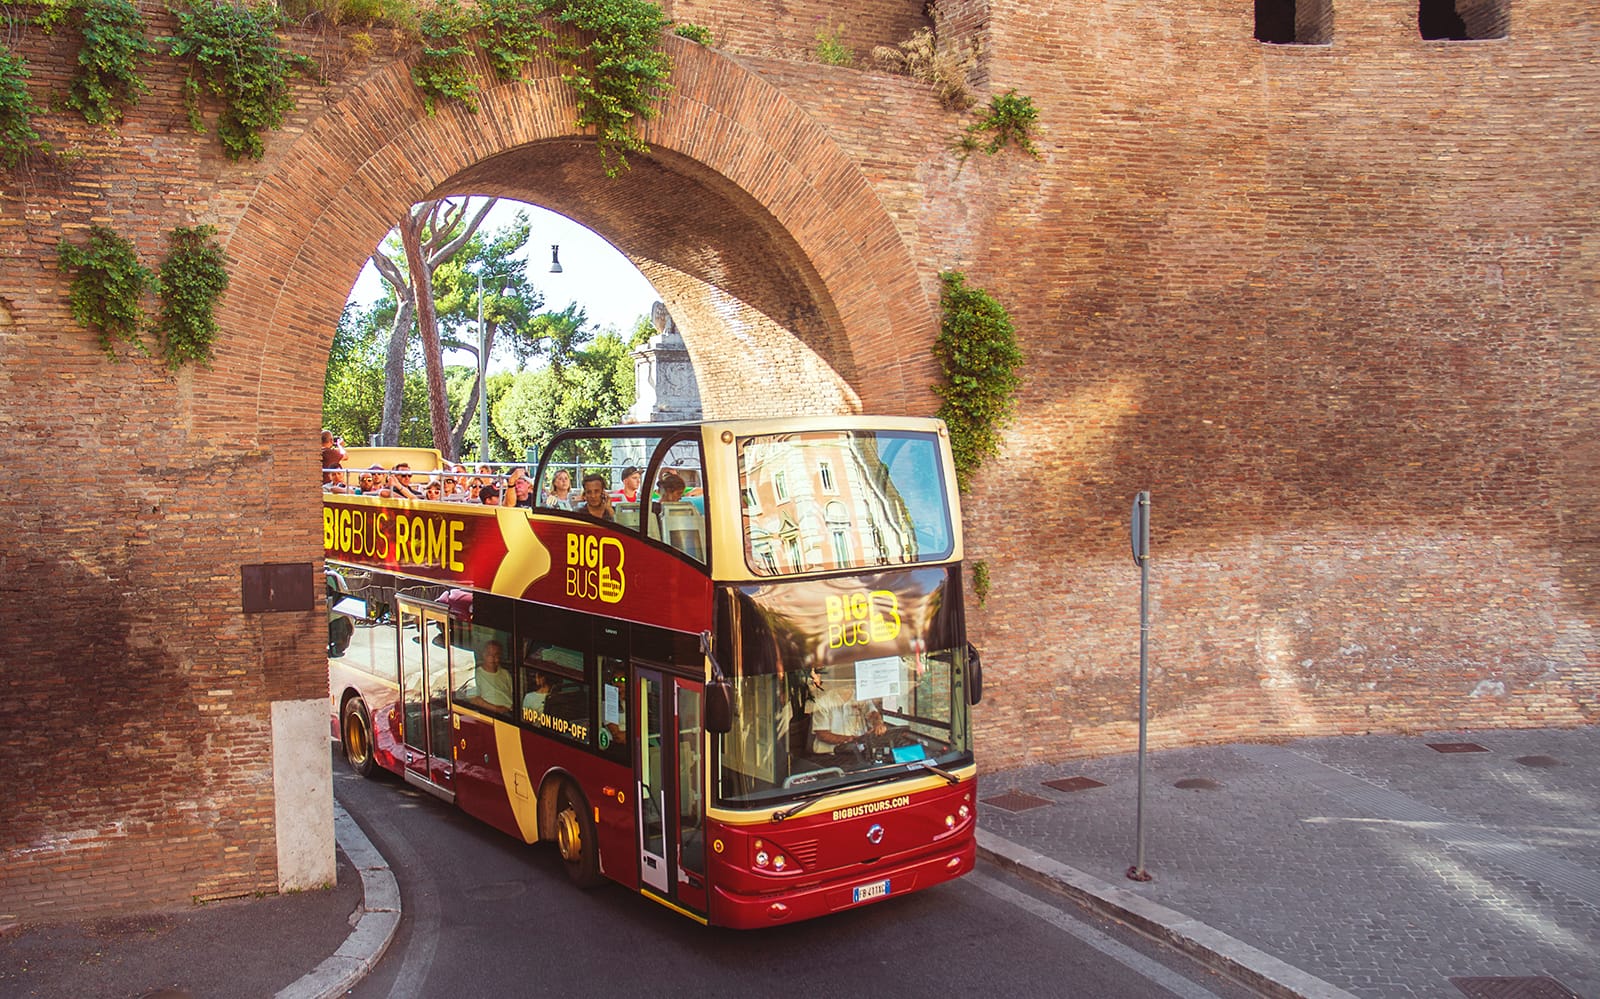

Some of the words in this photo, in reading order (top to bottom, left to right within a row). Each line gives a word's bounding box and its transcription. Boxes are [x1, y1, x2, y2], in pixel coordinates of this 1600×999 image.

[395, 515, 465, 573] ROME
[567, 533, 598, 568] BIG
[566, 567, 598, 600] BUS
[825, 592, 868, 623] BIG
[829, 620, 870, 649] BUS
[522, 706, 551, 729] HOP-ON
[552, 716, 587, 740] HOP-OFF
[832, 796, 910, 821] BIGBUSTOURS.COM
